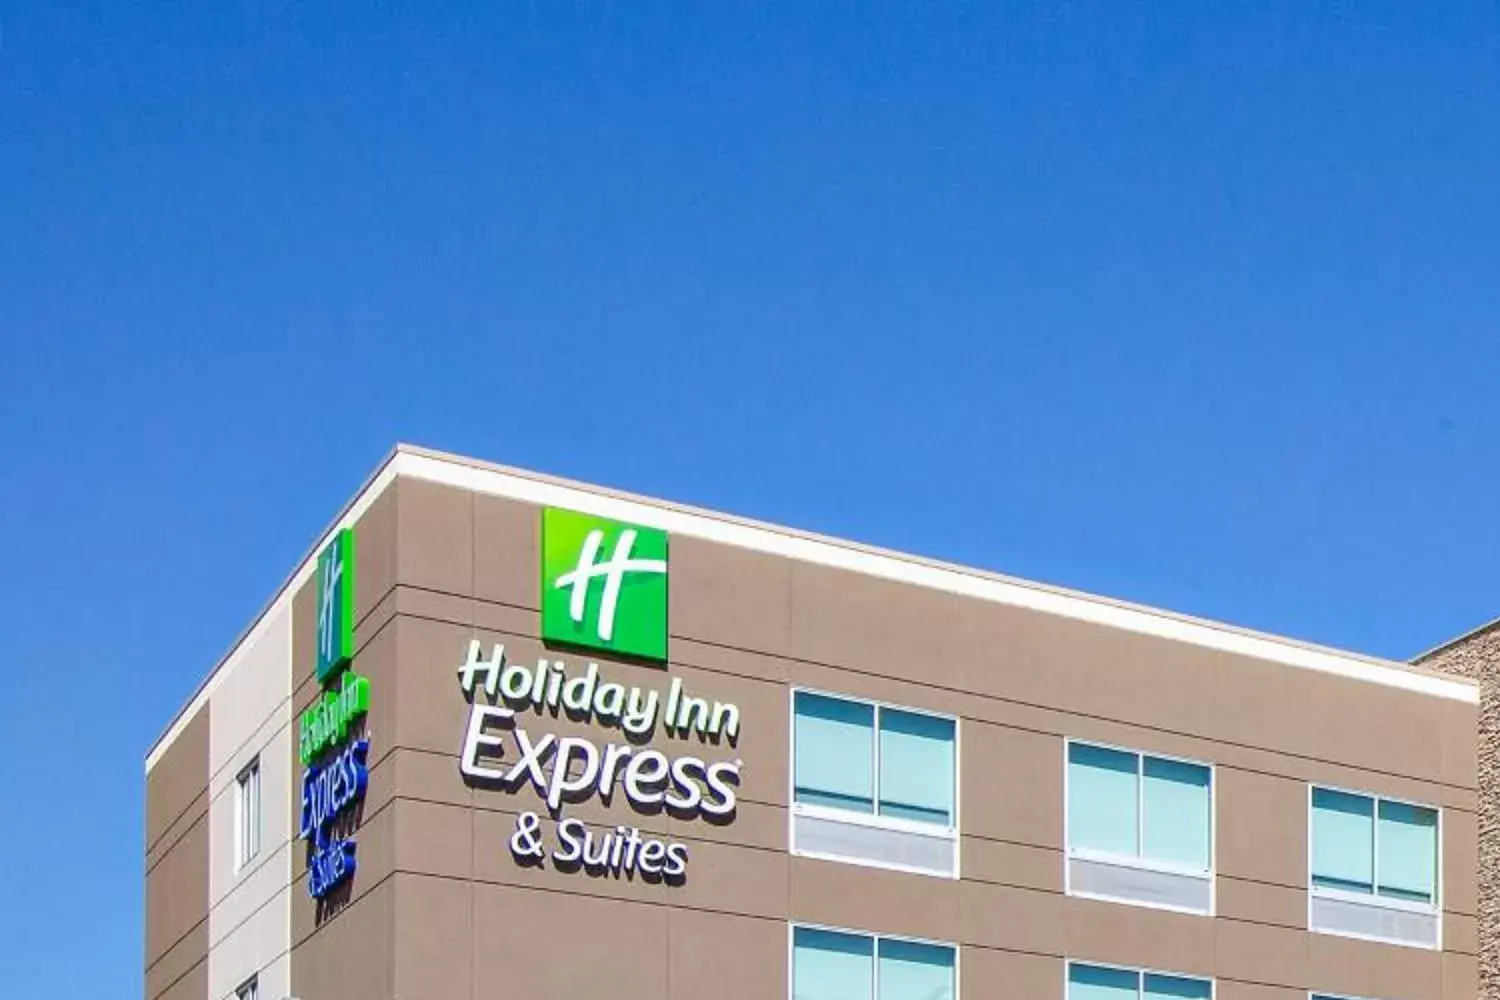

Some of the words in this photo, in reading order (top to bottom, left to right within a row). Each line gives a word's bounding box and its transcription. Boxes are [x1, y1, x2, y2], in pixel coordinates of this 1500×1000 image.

[554, 528, 668, 641] H
[457, 638, 659, 734] Holiday
[665, 676, 739, 738] Inn
[300, 740, 364, 848] Express
[460, 702, 740, 815] Express
[510, 811, 544, 858] &
[552, 817, 690, 876] Suites
